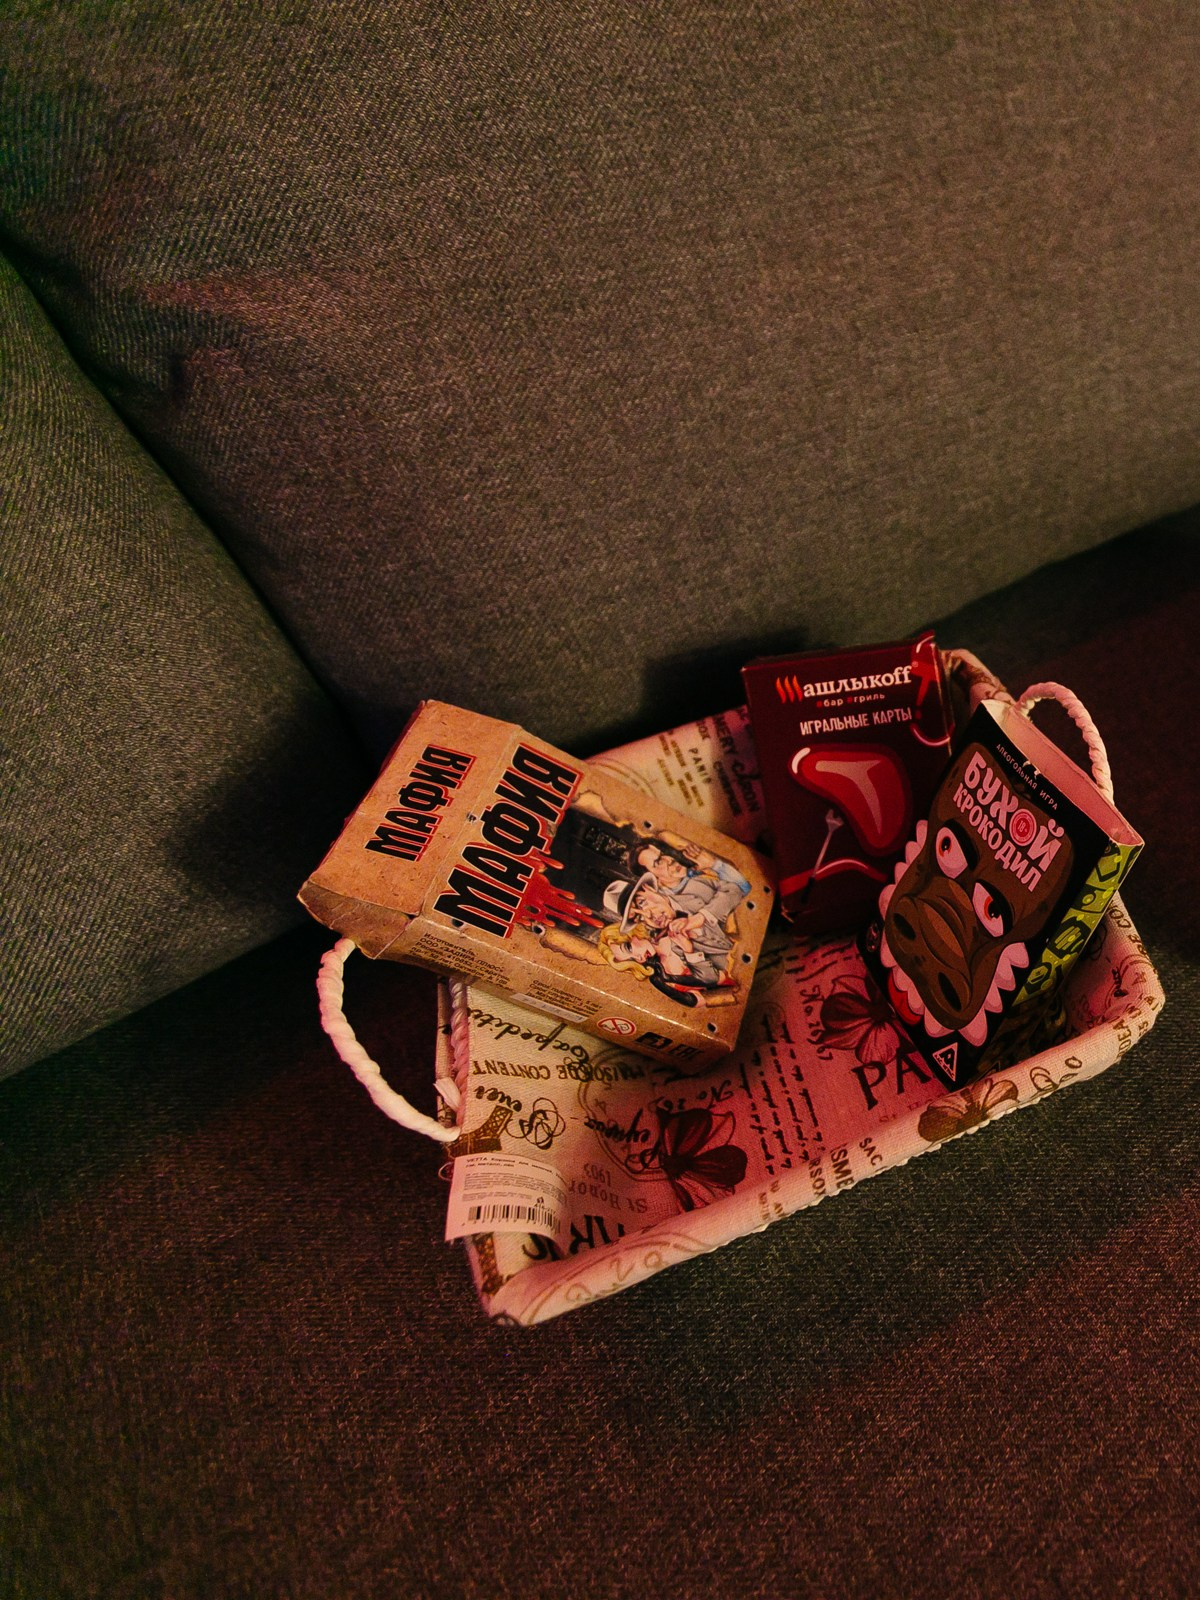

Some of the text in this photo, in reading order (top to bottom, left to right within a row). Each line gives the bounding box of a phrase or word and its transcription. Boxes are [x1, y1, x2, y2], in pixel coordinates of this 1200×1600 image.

[800, 707, 913, 736] ИГРАЛЬНЫЕ КАРТЫ
[823, 693, 886, 707] бар гриль
[365, 744, 477, 862] МАФИЯ
[964, 751, 1065, 872] БУХОЙ
[996, 743, 1058, 811] АЛКОГОЛЬНАЯ ИГРА
[433, 742, 584, 939] МАФИЯ
[953, 782, 1042, 893] КРОКОДИЛ
[418, 936, 439, 948] ООО
